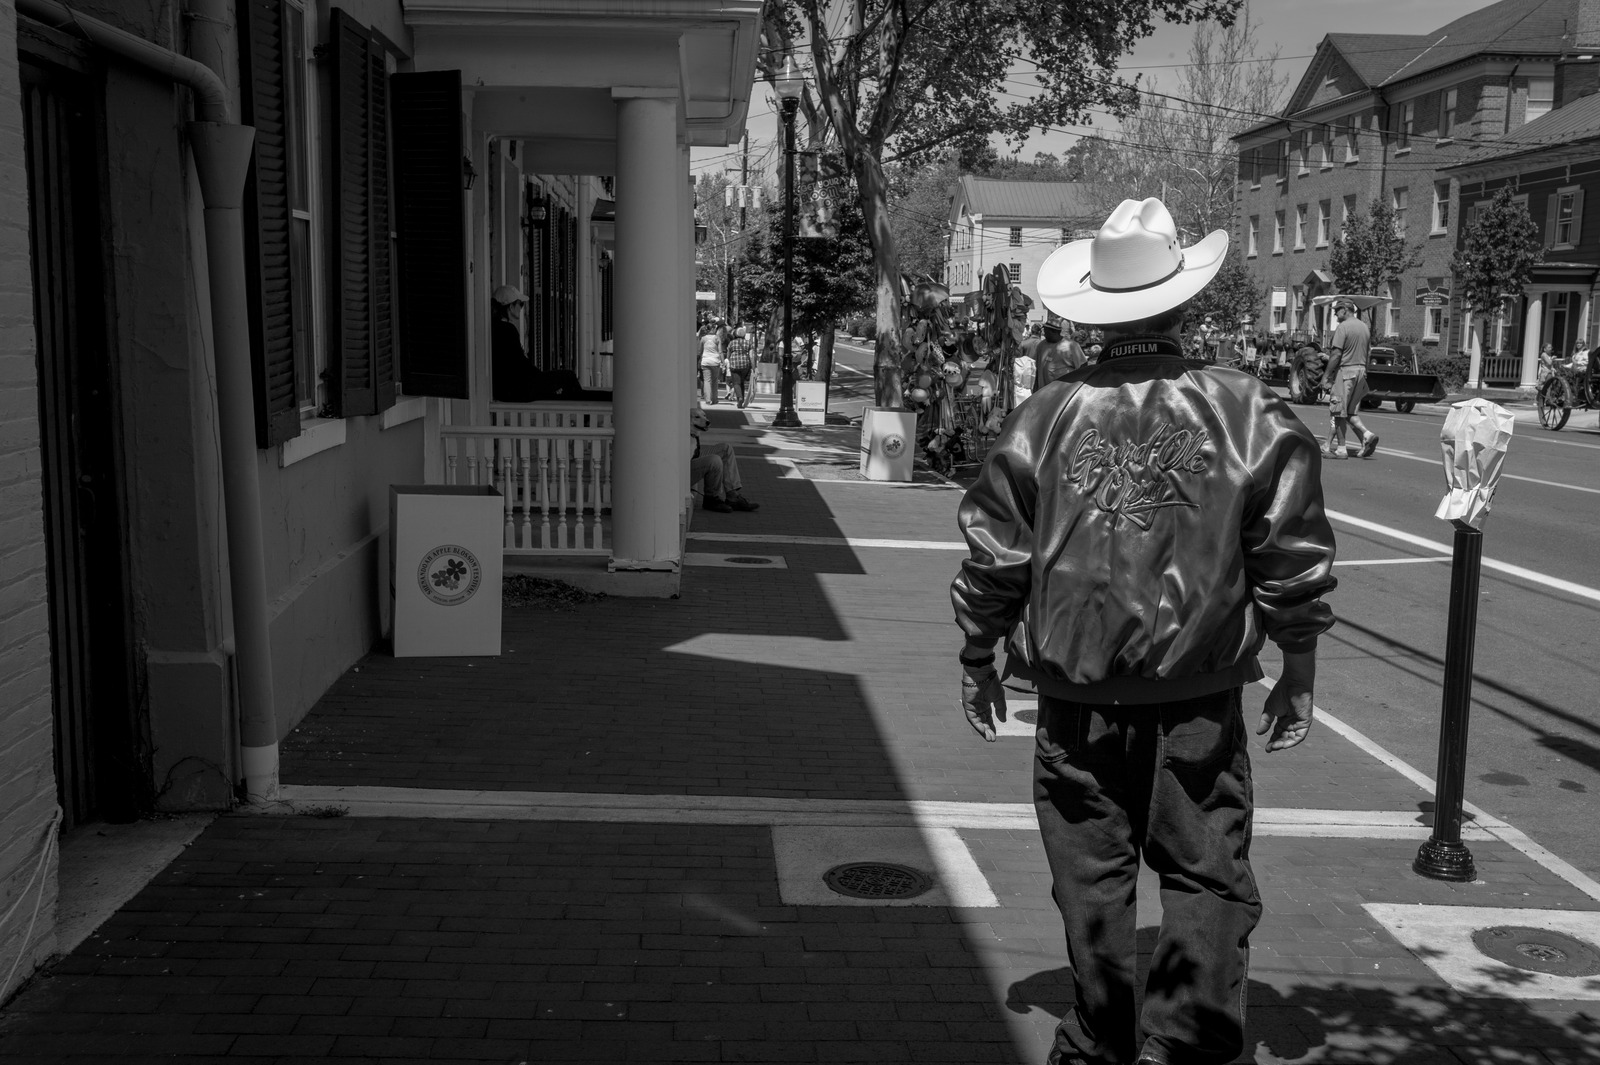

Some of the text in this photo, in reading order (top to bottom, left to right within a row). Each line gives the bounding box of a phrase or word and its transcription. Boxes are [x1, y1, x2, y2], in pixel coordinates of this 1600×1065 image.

[801, 178, 839, 193] GET YOUR
[1110, 343, 1158, 358] FUJIFILM
[1066, 422, 1208, 488] Grand Ole
[1095, 466, 1200, 531] Opry
[432, 546, 452, 558] APPLE
[452, 547, 478, 568] BLOSSOM
